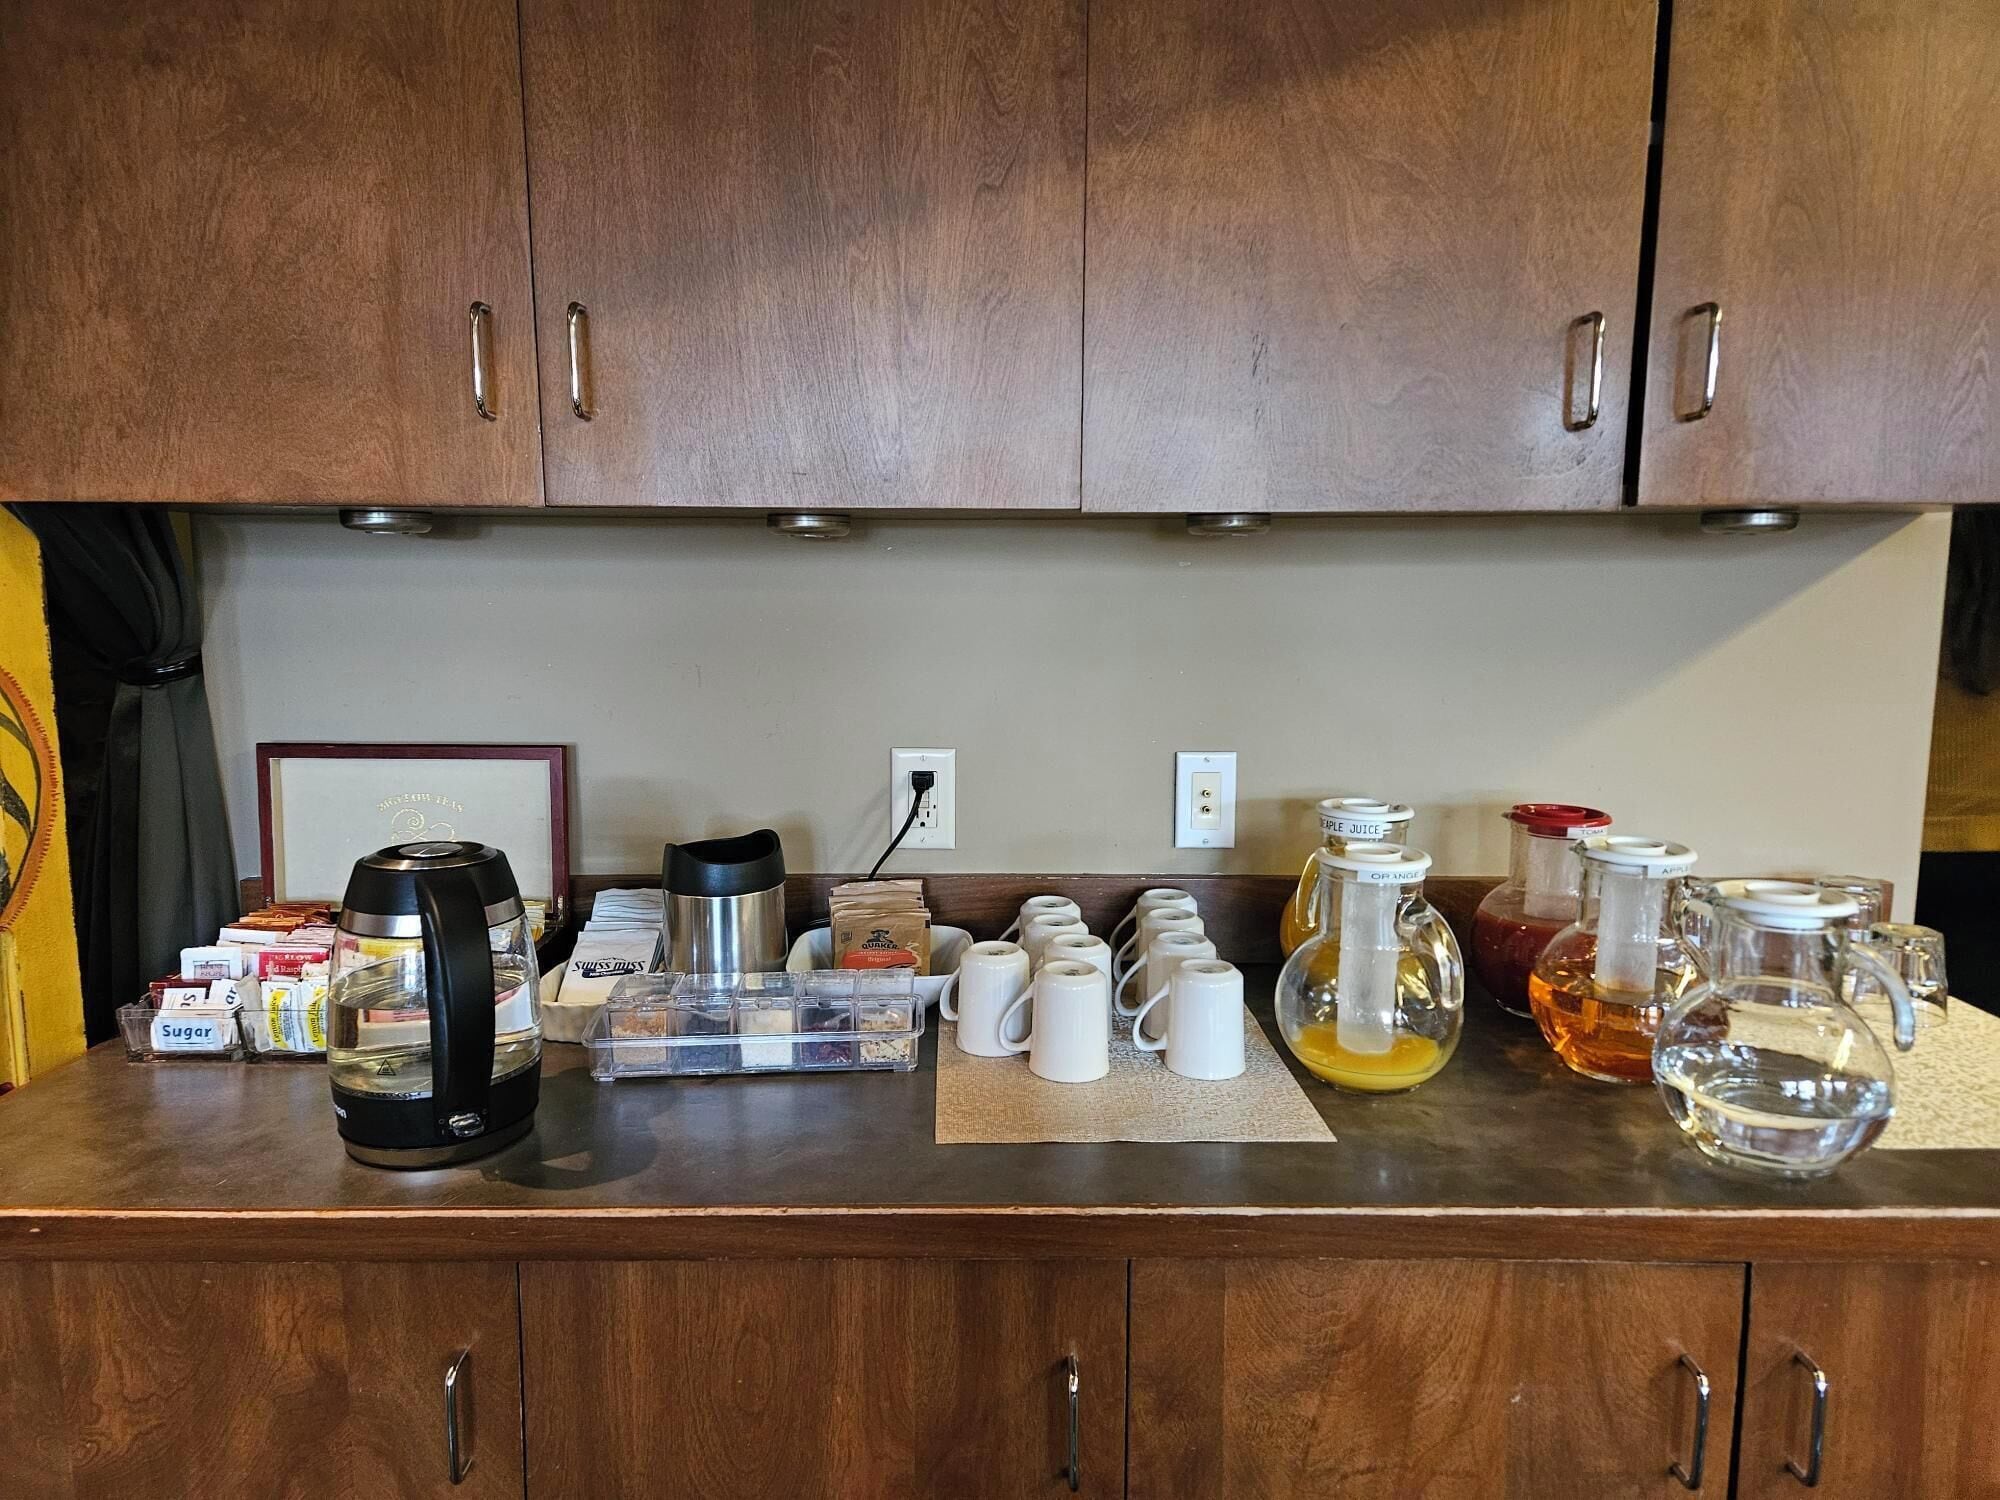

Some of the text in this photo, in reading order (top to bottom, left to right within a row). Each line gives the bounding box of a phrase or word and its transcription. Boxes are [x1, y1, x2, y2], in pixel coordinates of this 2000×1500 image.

[1350, 824, 1380, 834] JUICE
[162, 1024, 212, 1040] Sugar
[270, 1017, 281, 1043] Lemon
[310, 1017, 319, 1043] Lemon
